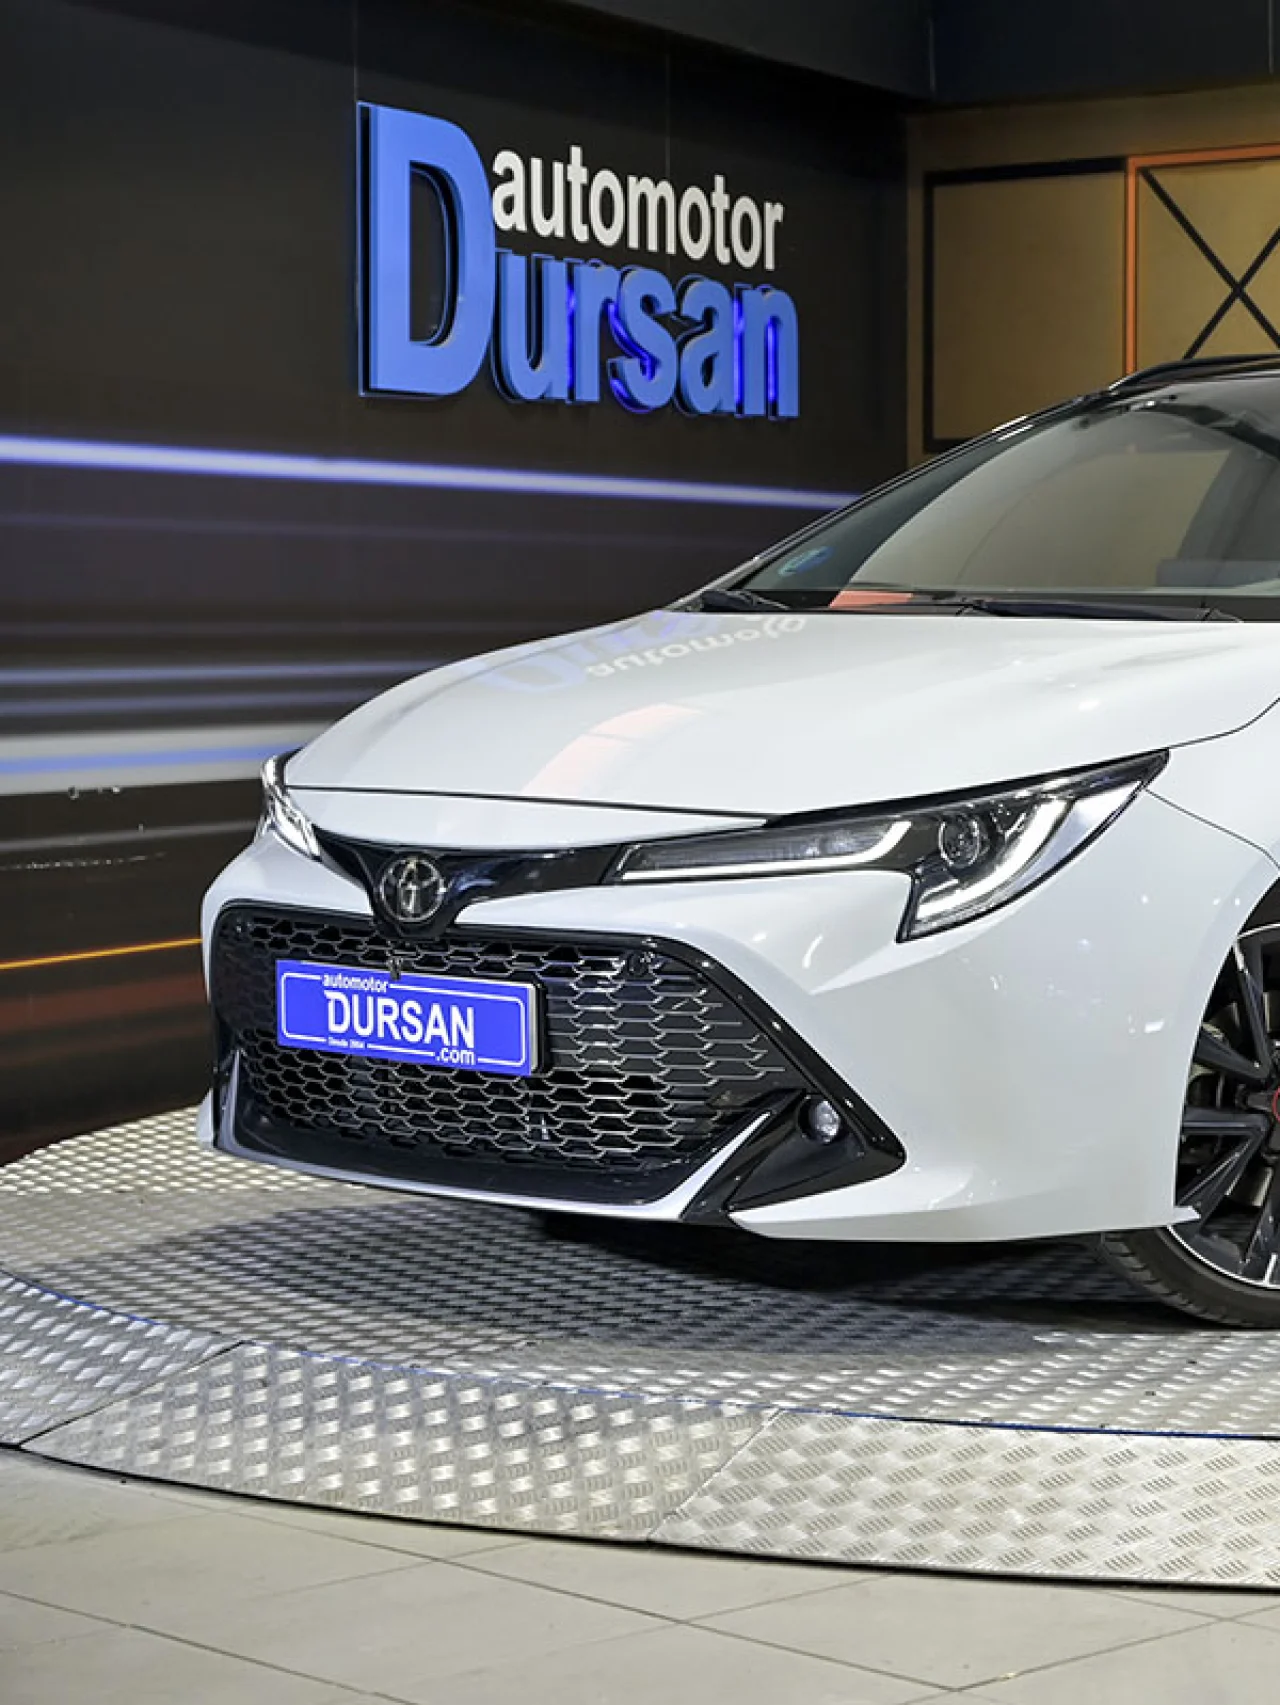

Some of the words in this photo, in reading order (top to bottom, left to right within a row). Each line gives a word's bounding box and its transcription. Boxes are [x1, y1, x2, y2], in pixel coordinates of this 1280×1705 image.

[491, 144, 784, 271] automotor
[357, 101, 799, 420] Dursan
[321, 973, 390, 993] automotor
[323, 989, 475, 1049] DURSAN
[435, 1047, 476, 1066] .com
